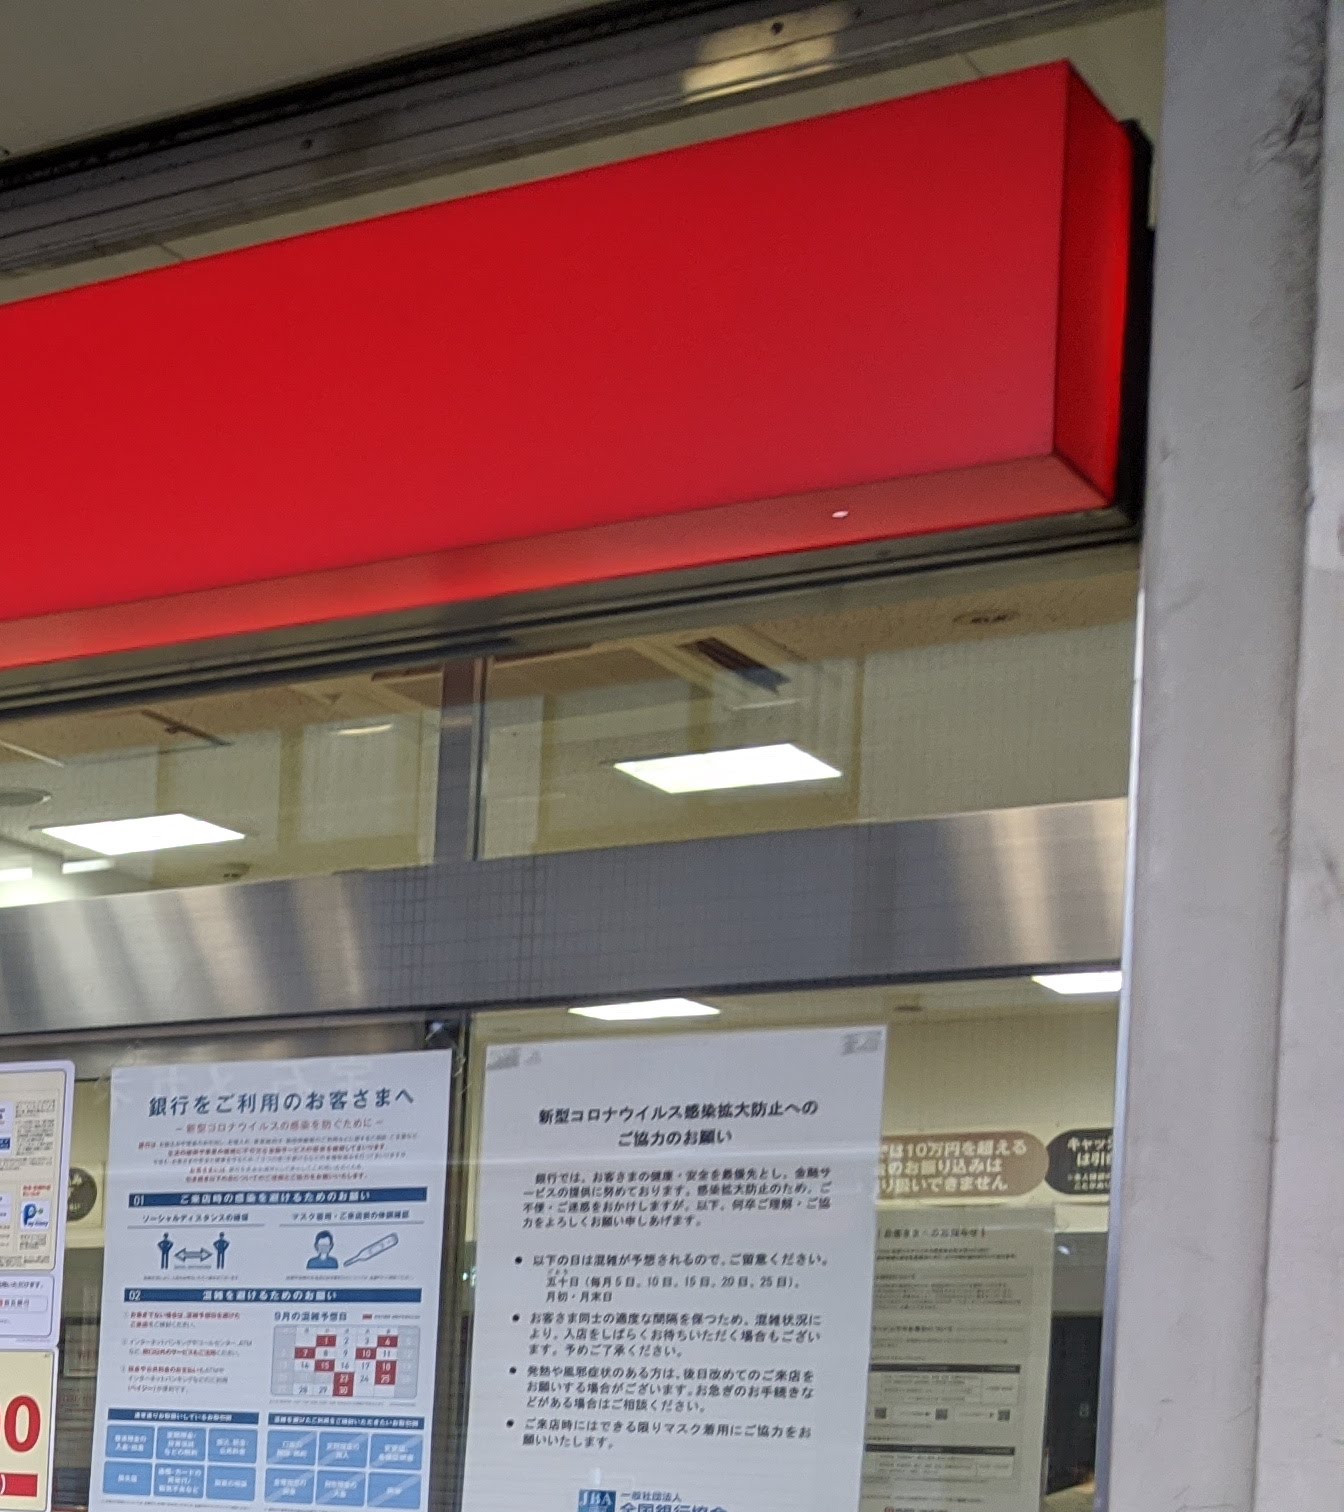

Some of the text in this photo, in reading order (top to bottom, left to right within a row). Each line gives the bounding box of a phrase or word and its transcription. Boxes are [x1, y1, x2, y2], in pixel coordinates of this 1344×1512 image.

[148, 1087, 414, 1118] 銀行をご利用のお客さまへ
[538, 1100, 819, 1125] 新型コロナウイルス感染拡大防止への
[618, 1128, 733, 1147] ご協力のお願い
